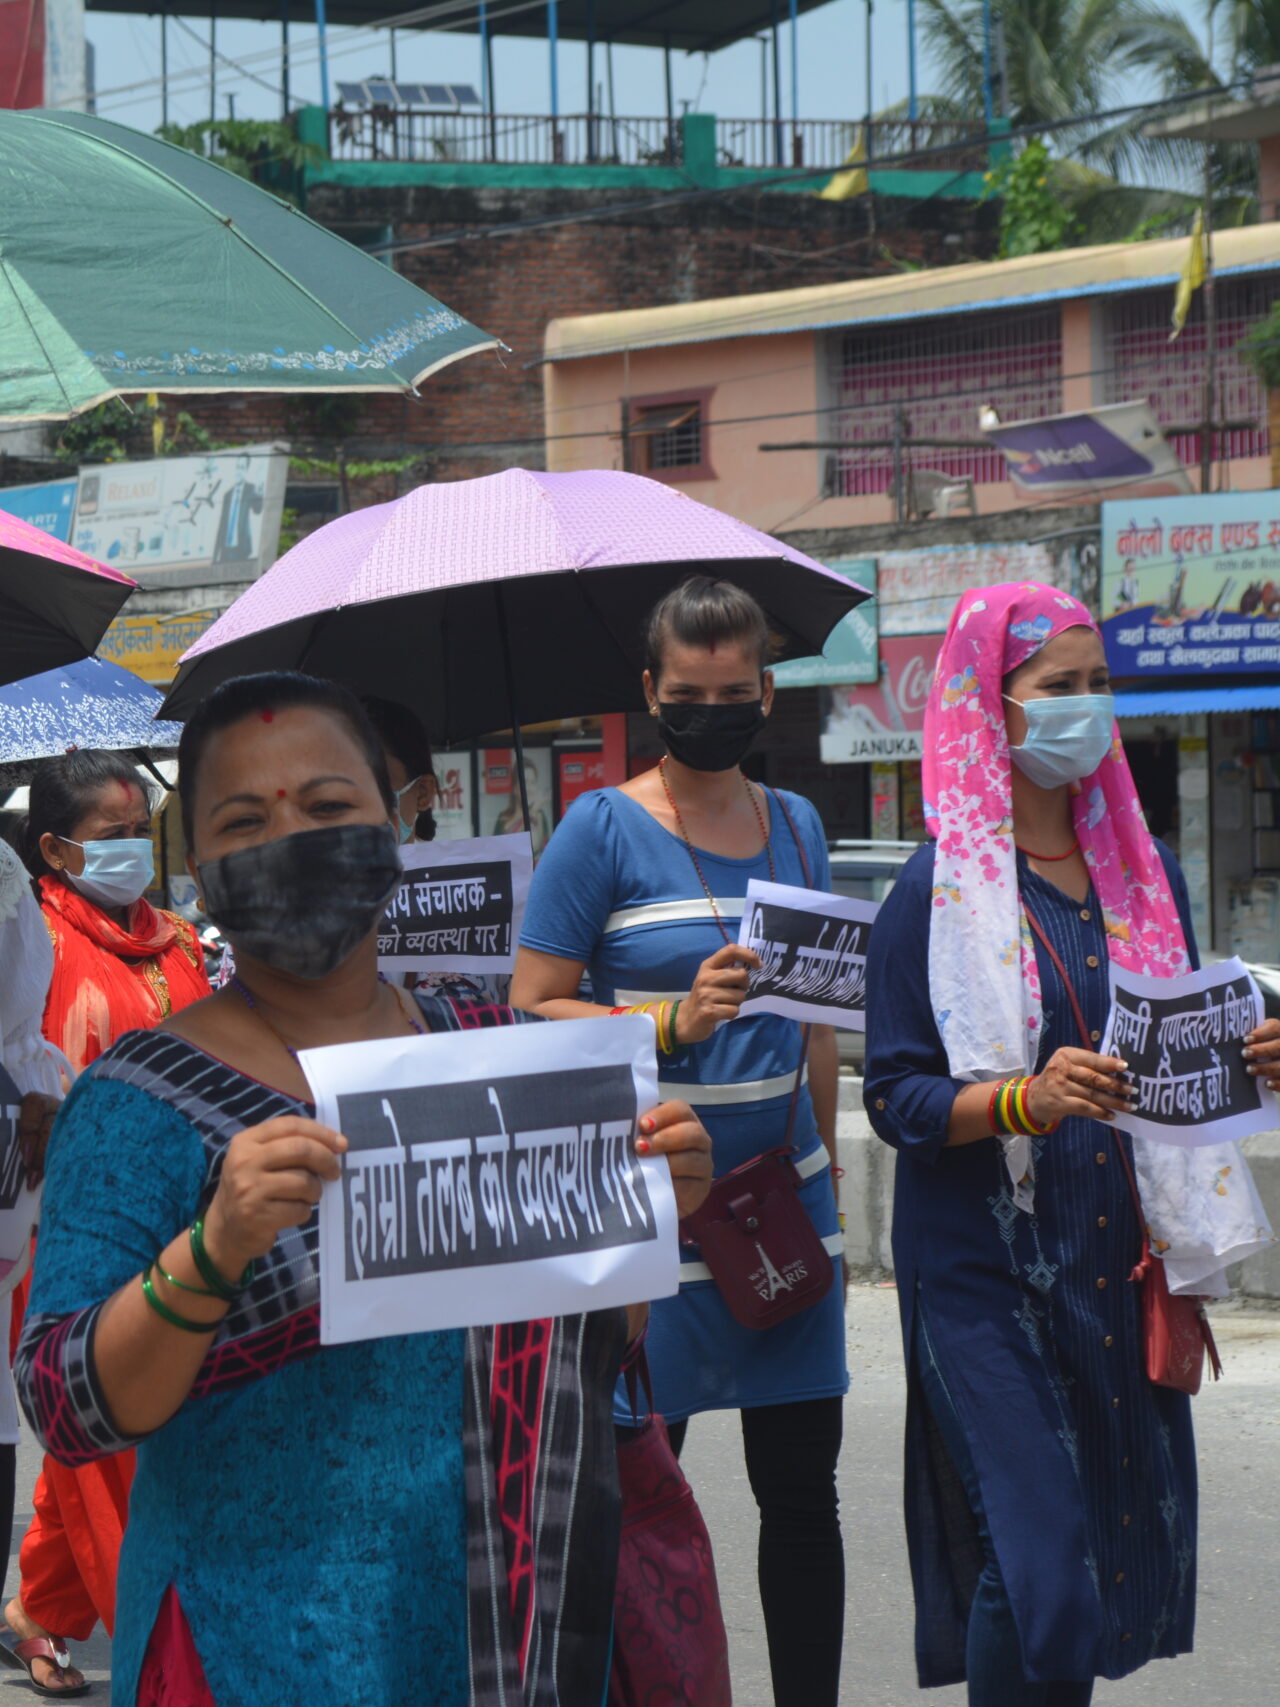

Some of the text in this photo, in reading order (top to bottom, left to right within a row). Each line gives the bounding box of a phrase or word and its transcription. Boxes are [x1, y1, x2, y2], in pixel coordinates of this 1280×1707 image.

[849, 738, 919, 757] JANUKA
[405, 926, 471, 953] व्यवस्था
[474, 924, 501, 953] गर
[1113, 1000, 1153, 1055] हामी
[345, 1098, 407, 1280] हाम्रो
[410, 1137, 476, 1257] तलब
[513, 1123, 604, 1241] व्यवस्था
[600, 1119, 649, 1229] गर
